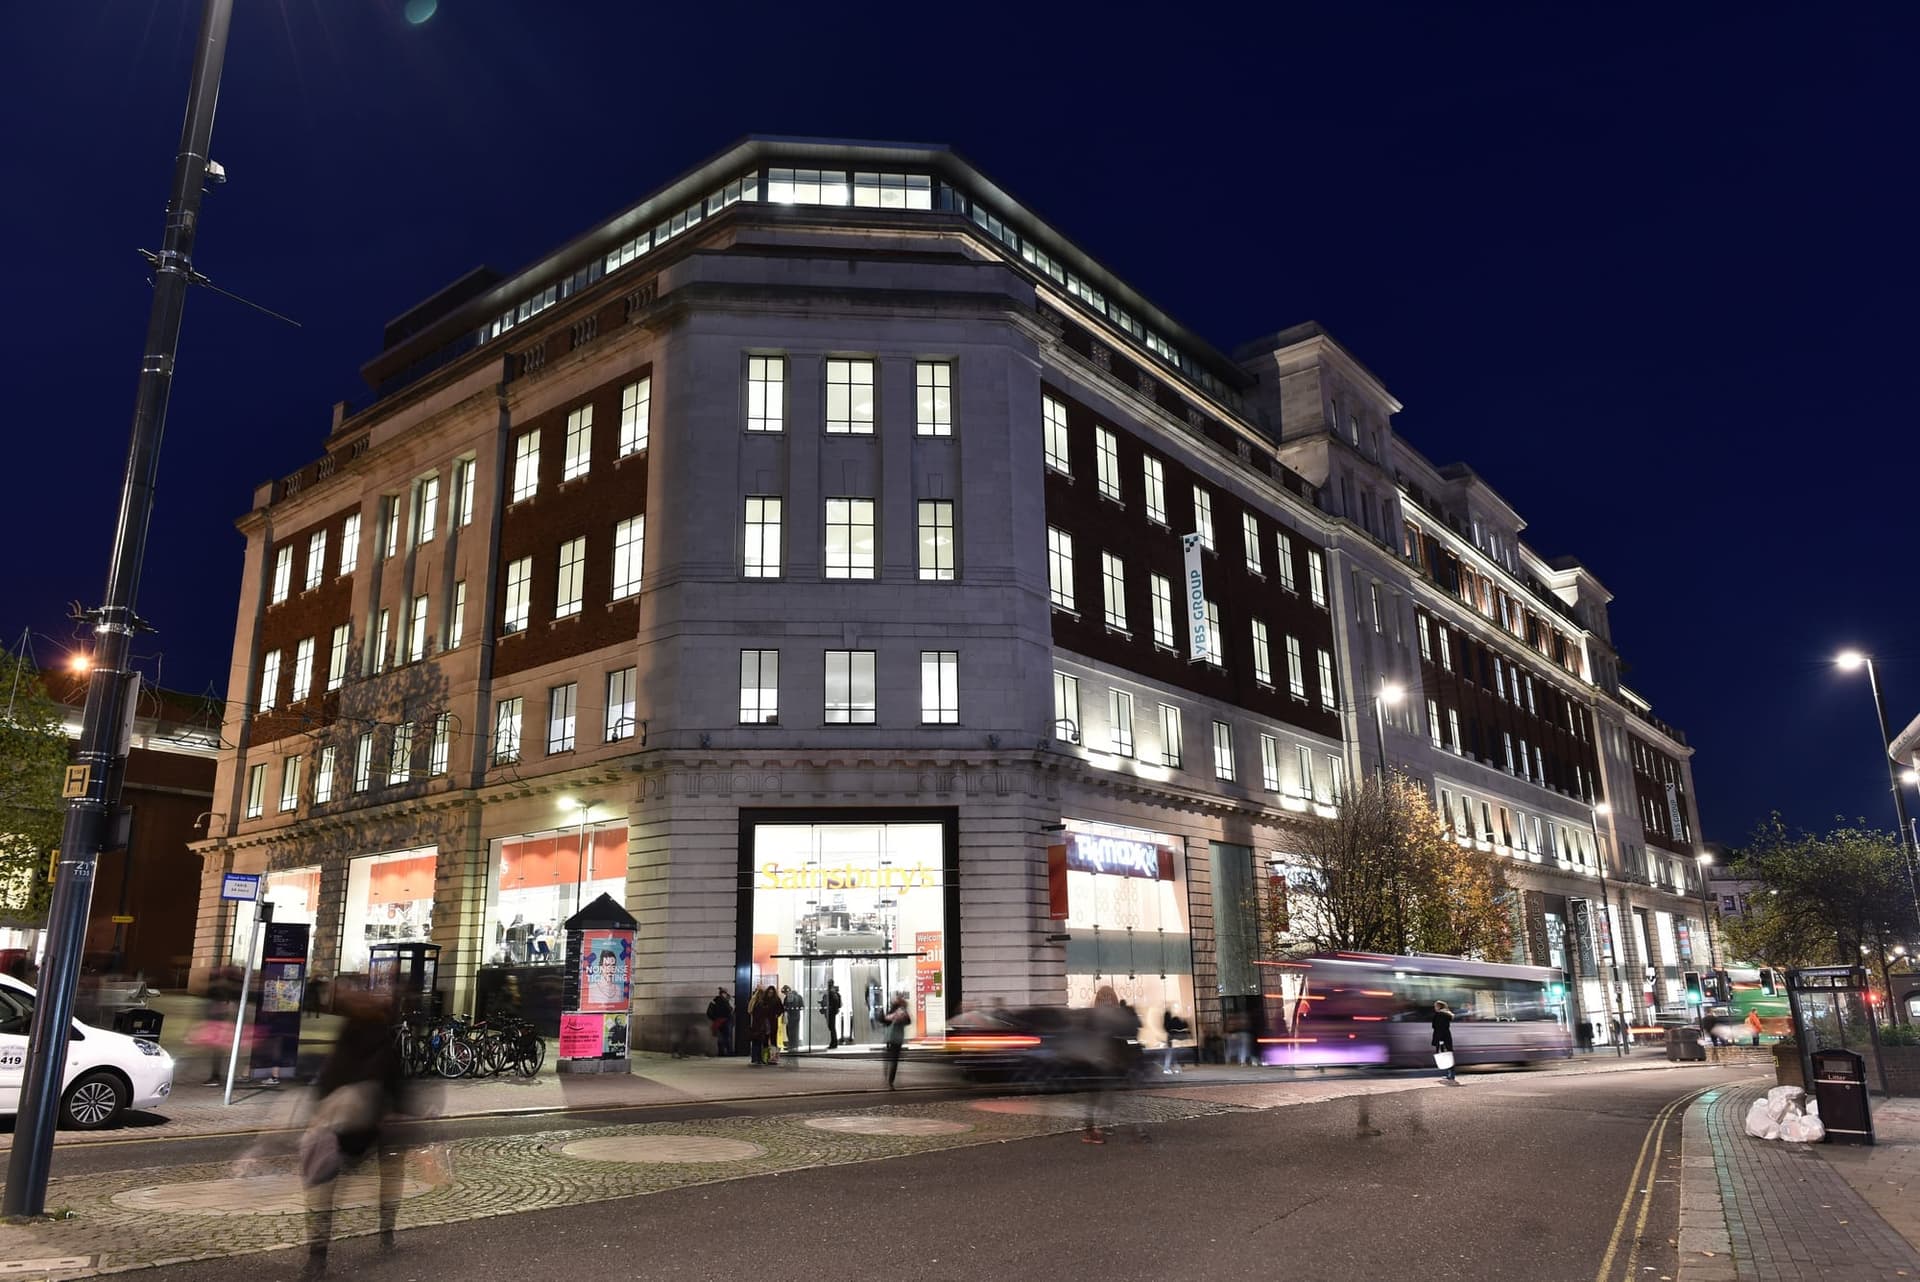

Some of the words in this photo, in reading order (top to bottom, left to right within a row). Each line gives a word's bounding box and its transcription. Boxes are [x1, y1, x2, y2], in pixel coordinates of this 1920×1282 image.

[1191, 570, 1204, 620] GROUP
[1195, 624, 1206, 654] YBS
[761, 861, 936, 895] Sainsbury's
[602, 956, 615, 965] NO
[586, 965, 629, 975] NONSENSE
[587, 974, 628, 983] TICKETING
[0, 1056, 22, 1065] 419
